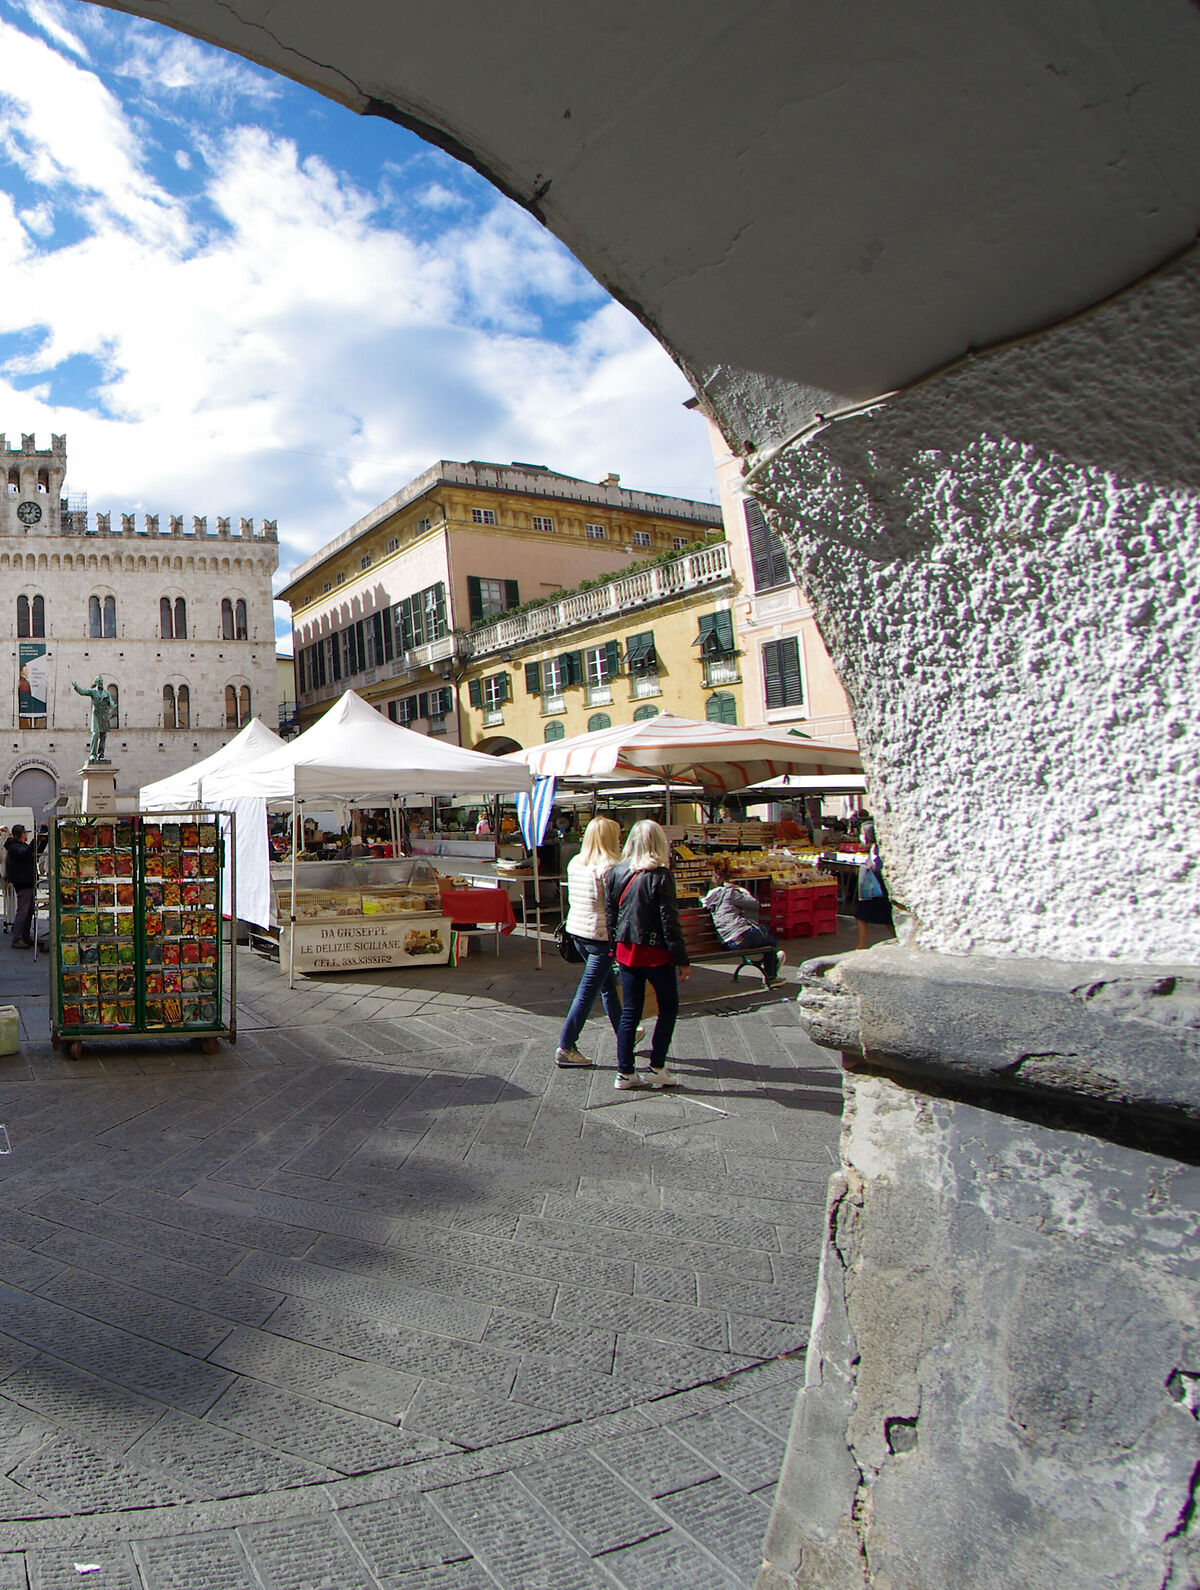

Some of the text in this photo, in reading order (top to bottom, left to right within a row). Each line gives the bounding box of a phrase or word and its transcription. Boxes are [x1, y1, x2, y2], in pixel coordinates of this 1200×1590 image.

[321, 927, 387, 938] DA GIUSEPPE
[301, 940, 400, 954] LE DELIZIE SICILIANE
[314, 959, 340, 967] CELL.
